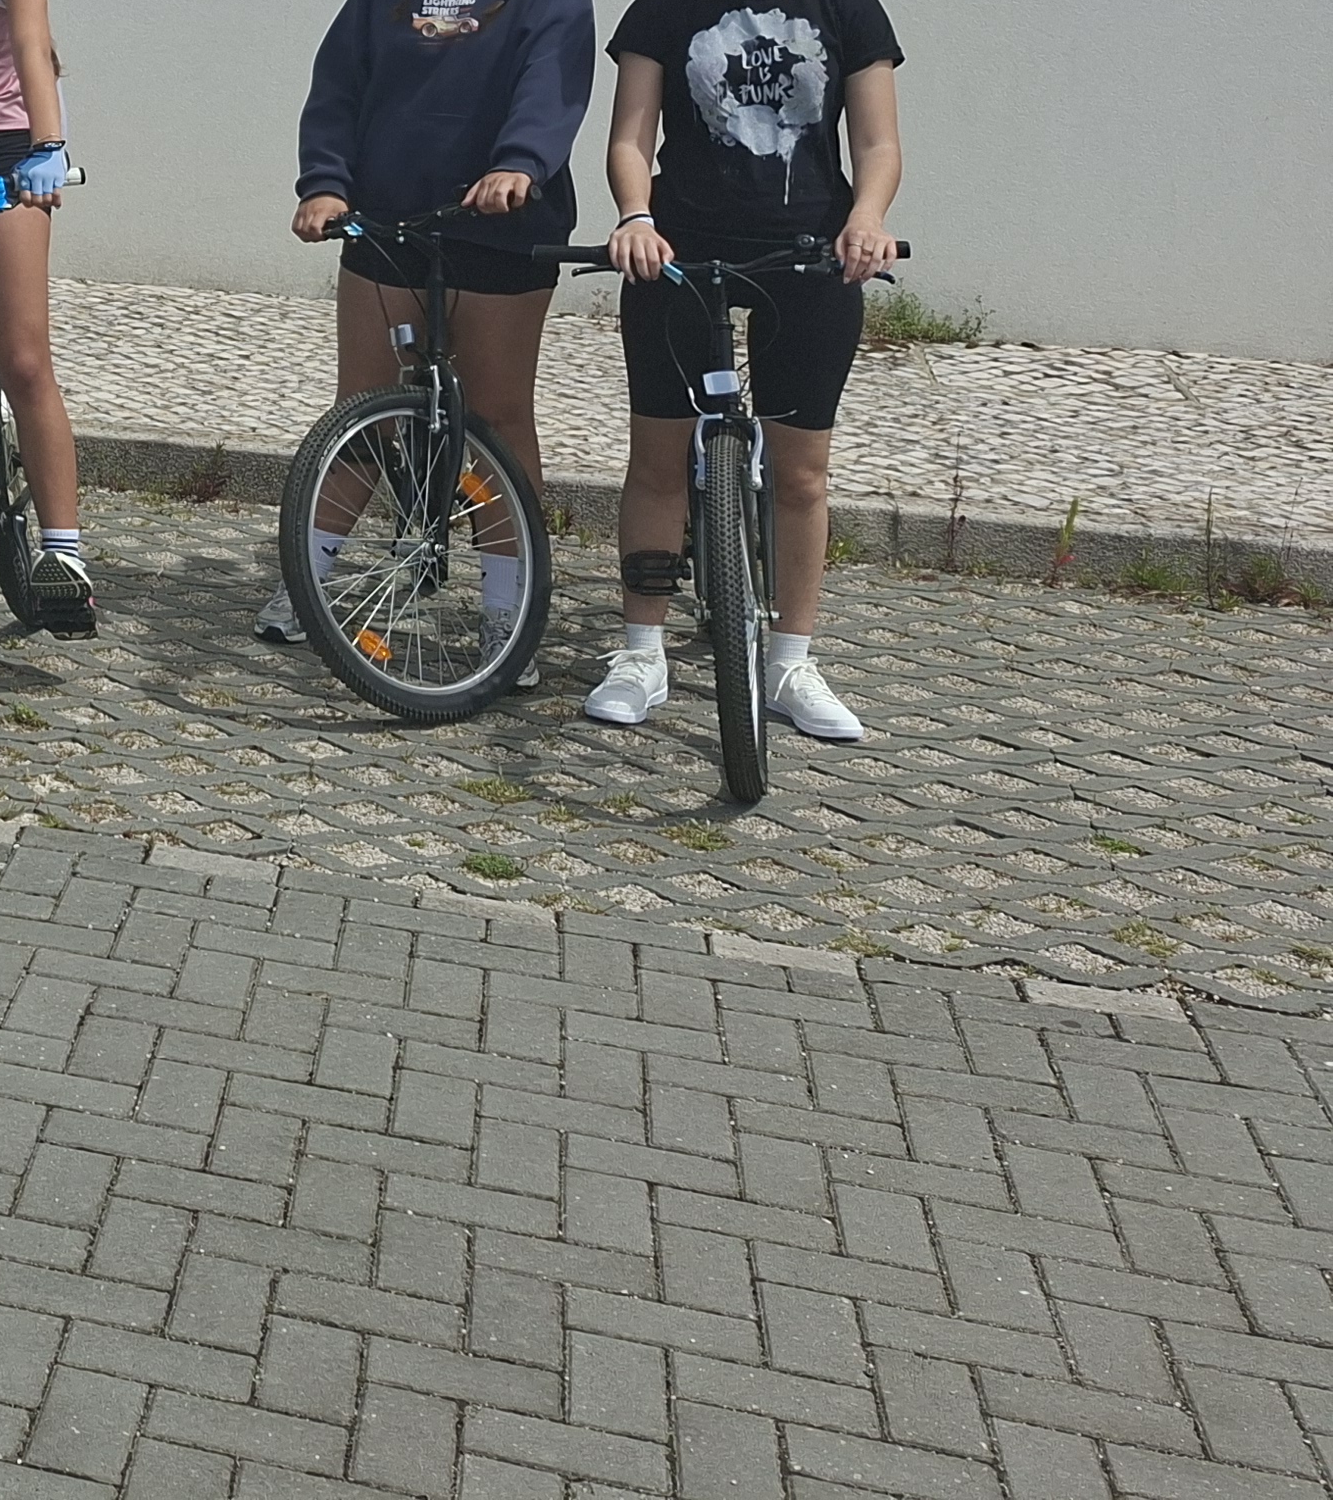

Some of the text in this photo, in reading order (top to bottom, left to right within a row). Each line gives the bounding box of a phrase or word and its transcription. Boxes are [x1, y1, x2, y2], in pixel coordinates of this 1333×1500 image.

[421, 6, 460, 16] STRIKES
[742, 45, 783, 70] LOVE
[759, 67, 771, 83] IS
[739, 80, 795, 105] PUNK
